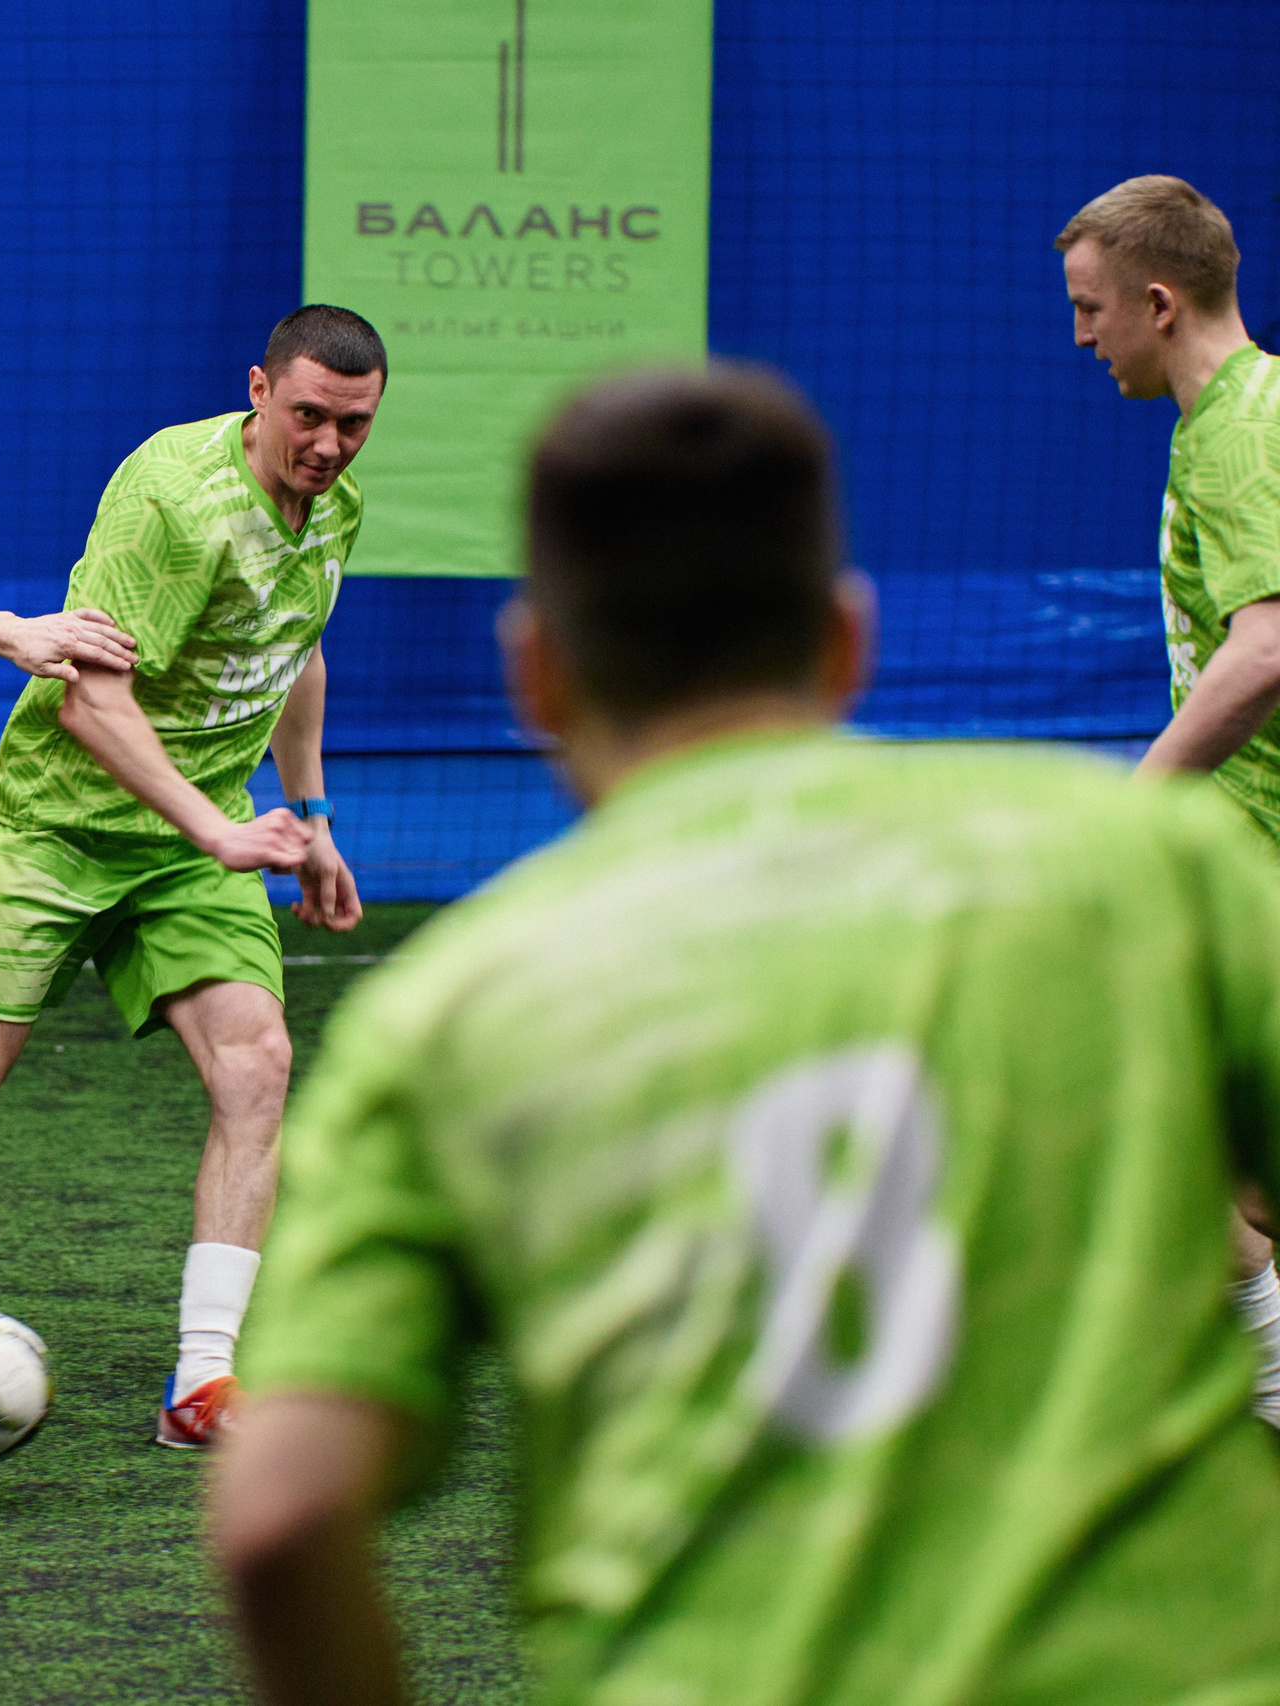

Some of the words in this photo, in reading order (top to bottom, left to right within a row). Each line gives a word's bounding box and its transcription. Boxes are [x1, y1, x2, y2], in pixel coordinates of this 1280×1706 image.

[356, 203, 661, 240] БАЛАНС
[391, 250, 630, 293] TOWERS
[730, 1040, 960, 1442] 8
